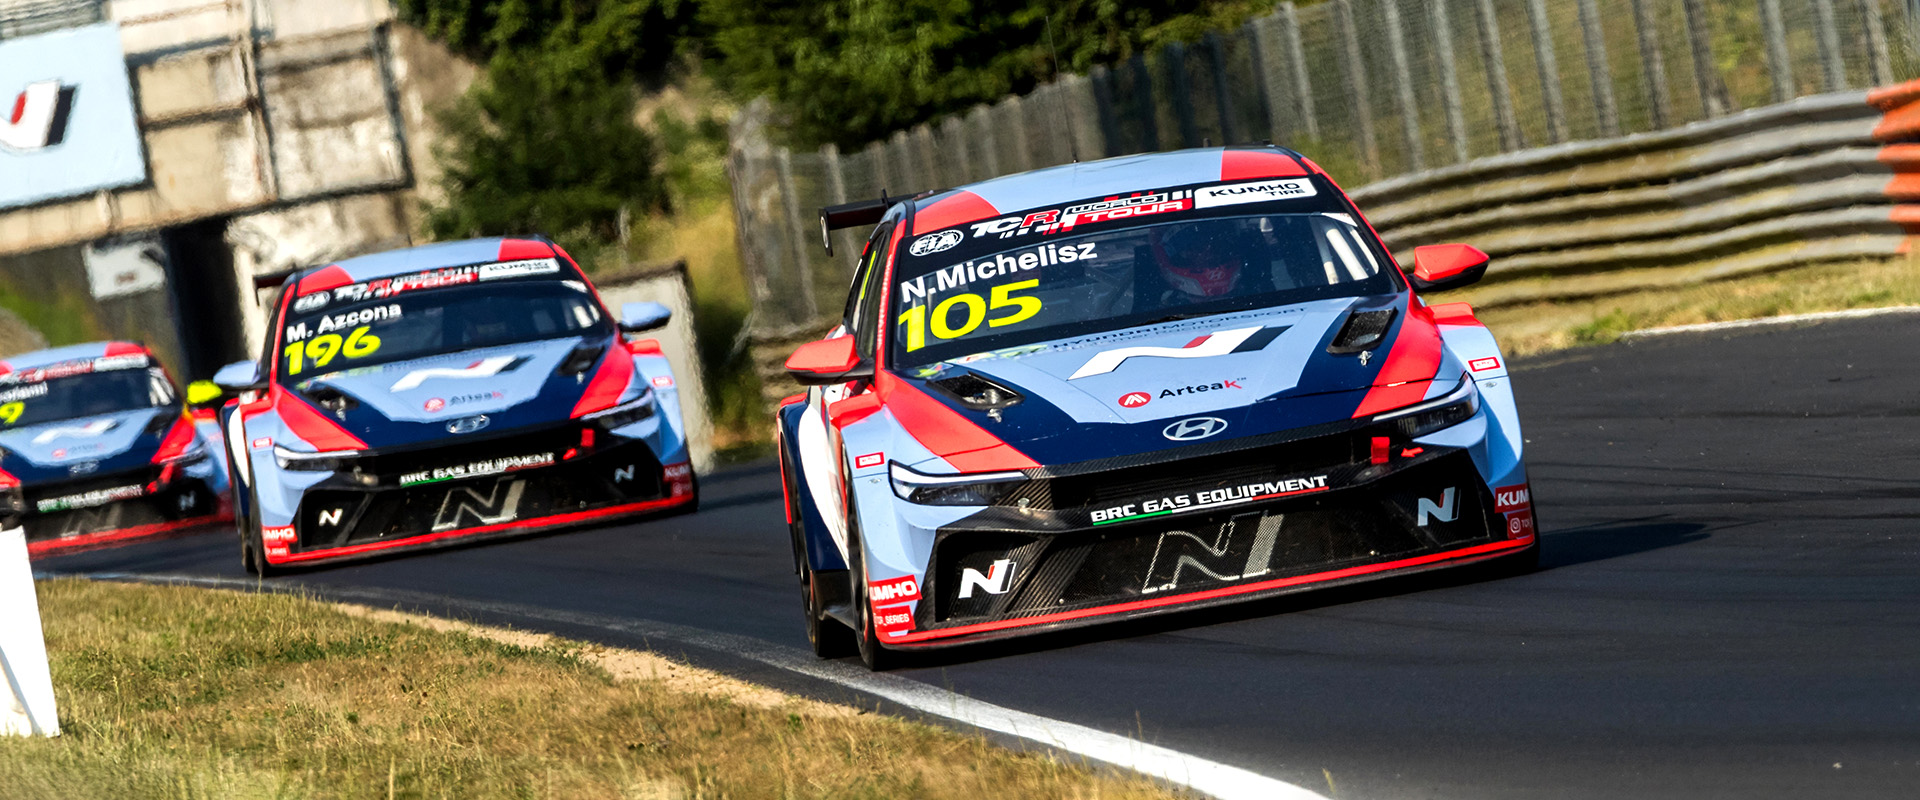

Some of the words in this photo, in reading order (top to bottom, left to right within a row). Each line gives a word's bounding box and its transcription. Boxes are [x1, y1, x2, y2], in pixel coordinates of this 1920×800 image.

[1208, 182, 1300, 198] KUMHO
[1264, 188, 1306, 197] TIRE
[1071, 194, 1161, 213] WORLD
[1083, 201, 1184, 222] TOUR
[970, 208, 1061, 239] TCR
[911, 230, 959, 255] FIA
[488, 261, 549, 273] KUMHO
[900, 242, 1098, 304] N.Michelisz
[286, 322, 314, 344] M.
[317, 304, 403, 335] Azcona
[897, 278, 1042, 353] 105
[1162, 307, 1308, 330] MOTORSPORT
[284, 325, 382, 376] 196
[433, 465, 465, 479] GAS
[1089, 504, 1137, 523] BRC
[1142, 494, 1191, 513] GAS
[1196, 475, 1328, 505] EQUIPMENT
[1497, 488, 1530, 507] KUM
[869, 580, 917, 601] UMHO
